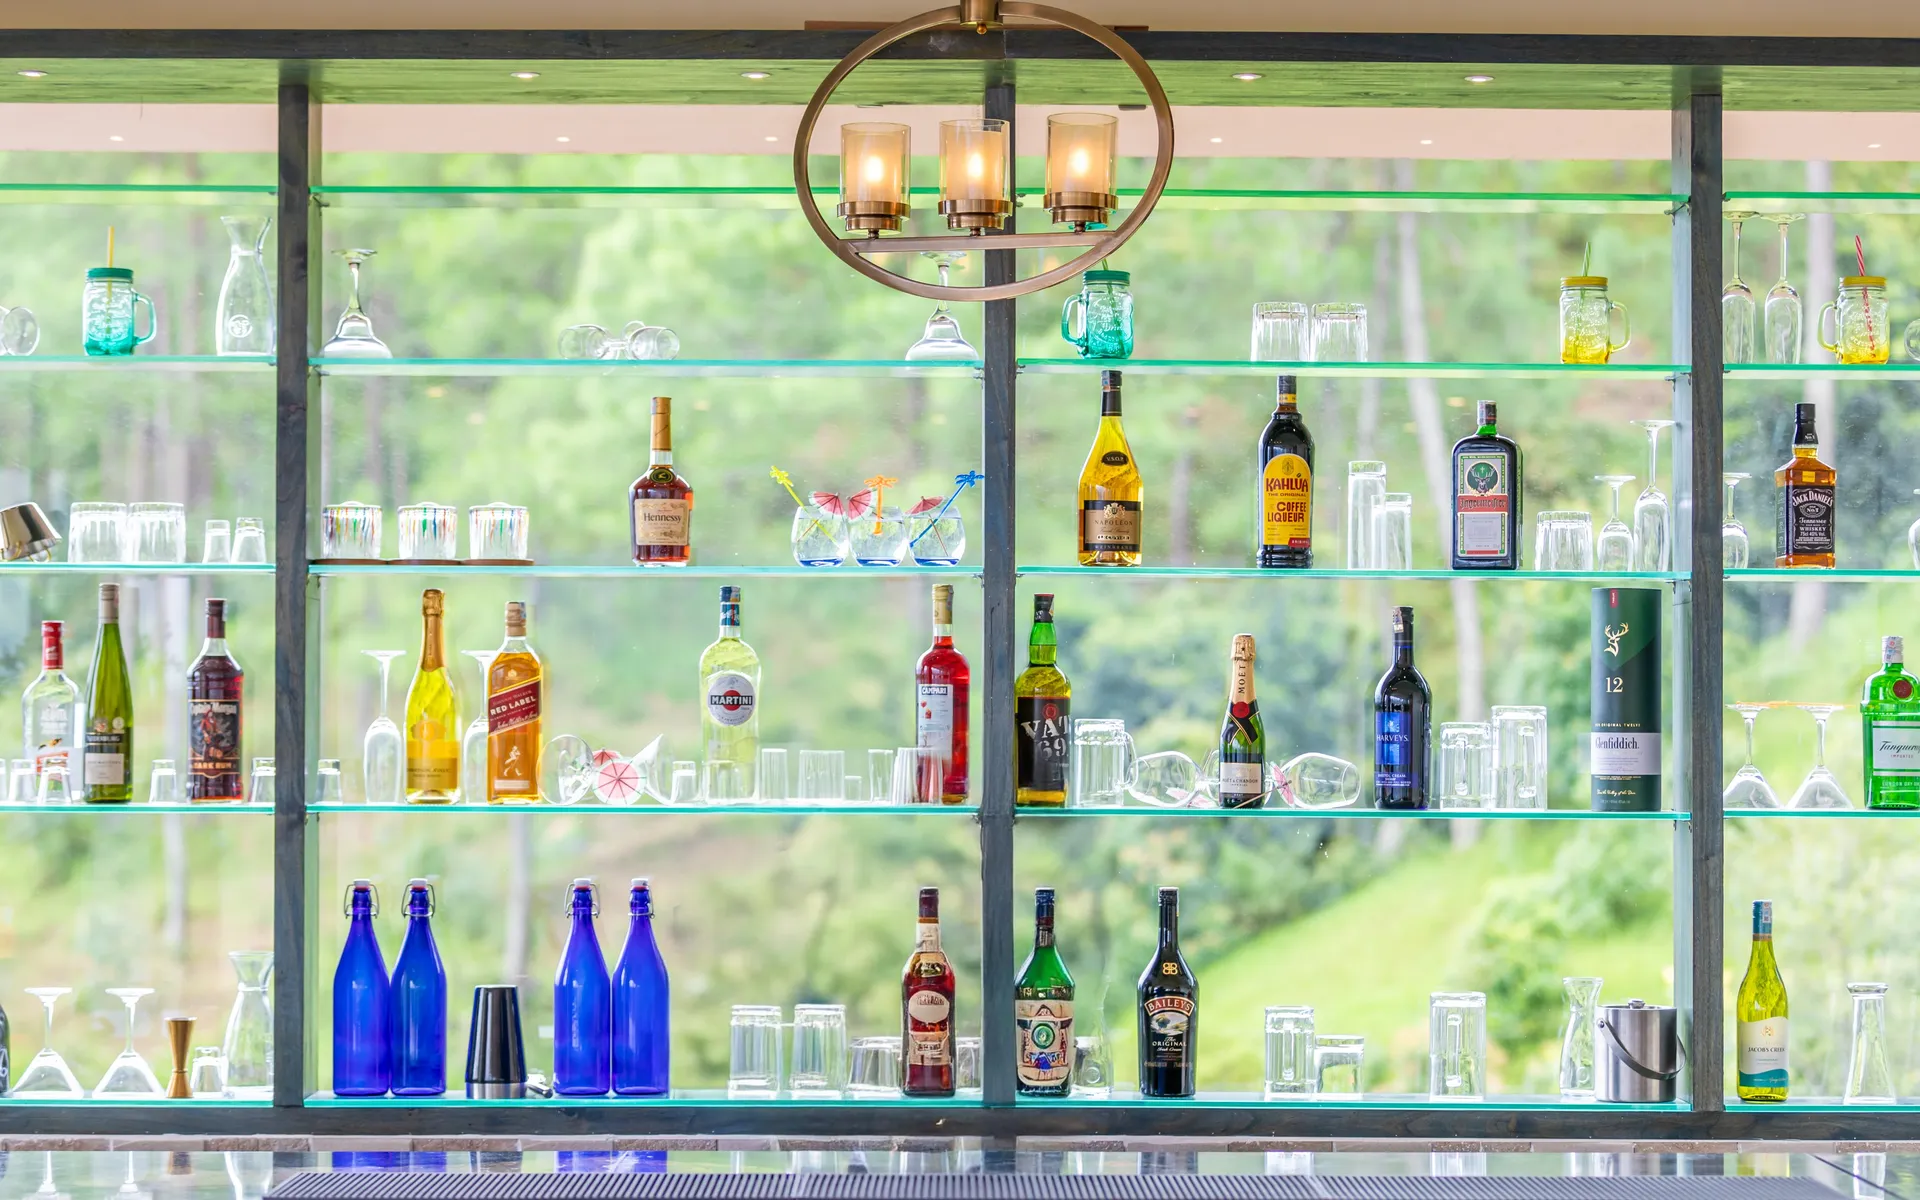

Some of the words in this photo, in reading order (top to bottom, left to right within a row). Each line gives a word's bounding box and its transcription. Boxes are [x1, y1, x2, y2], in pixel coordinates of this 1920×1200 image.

[1792, 493, 1809, 507] JACK
[1276, 501, 1307, 513] COFFEE
[643, 512, 682, 524] Hennessy
[1267, 512, 1305, 522] LIQUEUR
[1799, 516, 1827, 524] Tennessee
[921, 687, 947, 695] CAMPARI
[1605, 677, 1624, 693] 12
[490, 705, 508, 716] RED
[508, 695, 537, 709] LABEL
[711, 696, 753, 705] MARTINI
[1020, 715, 1069, 740] VAT
[1147, 998, 1193, 1011] BAILEYS
